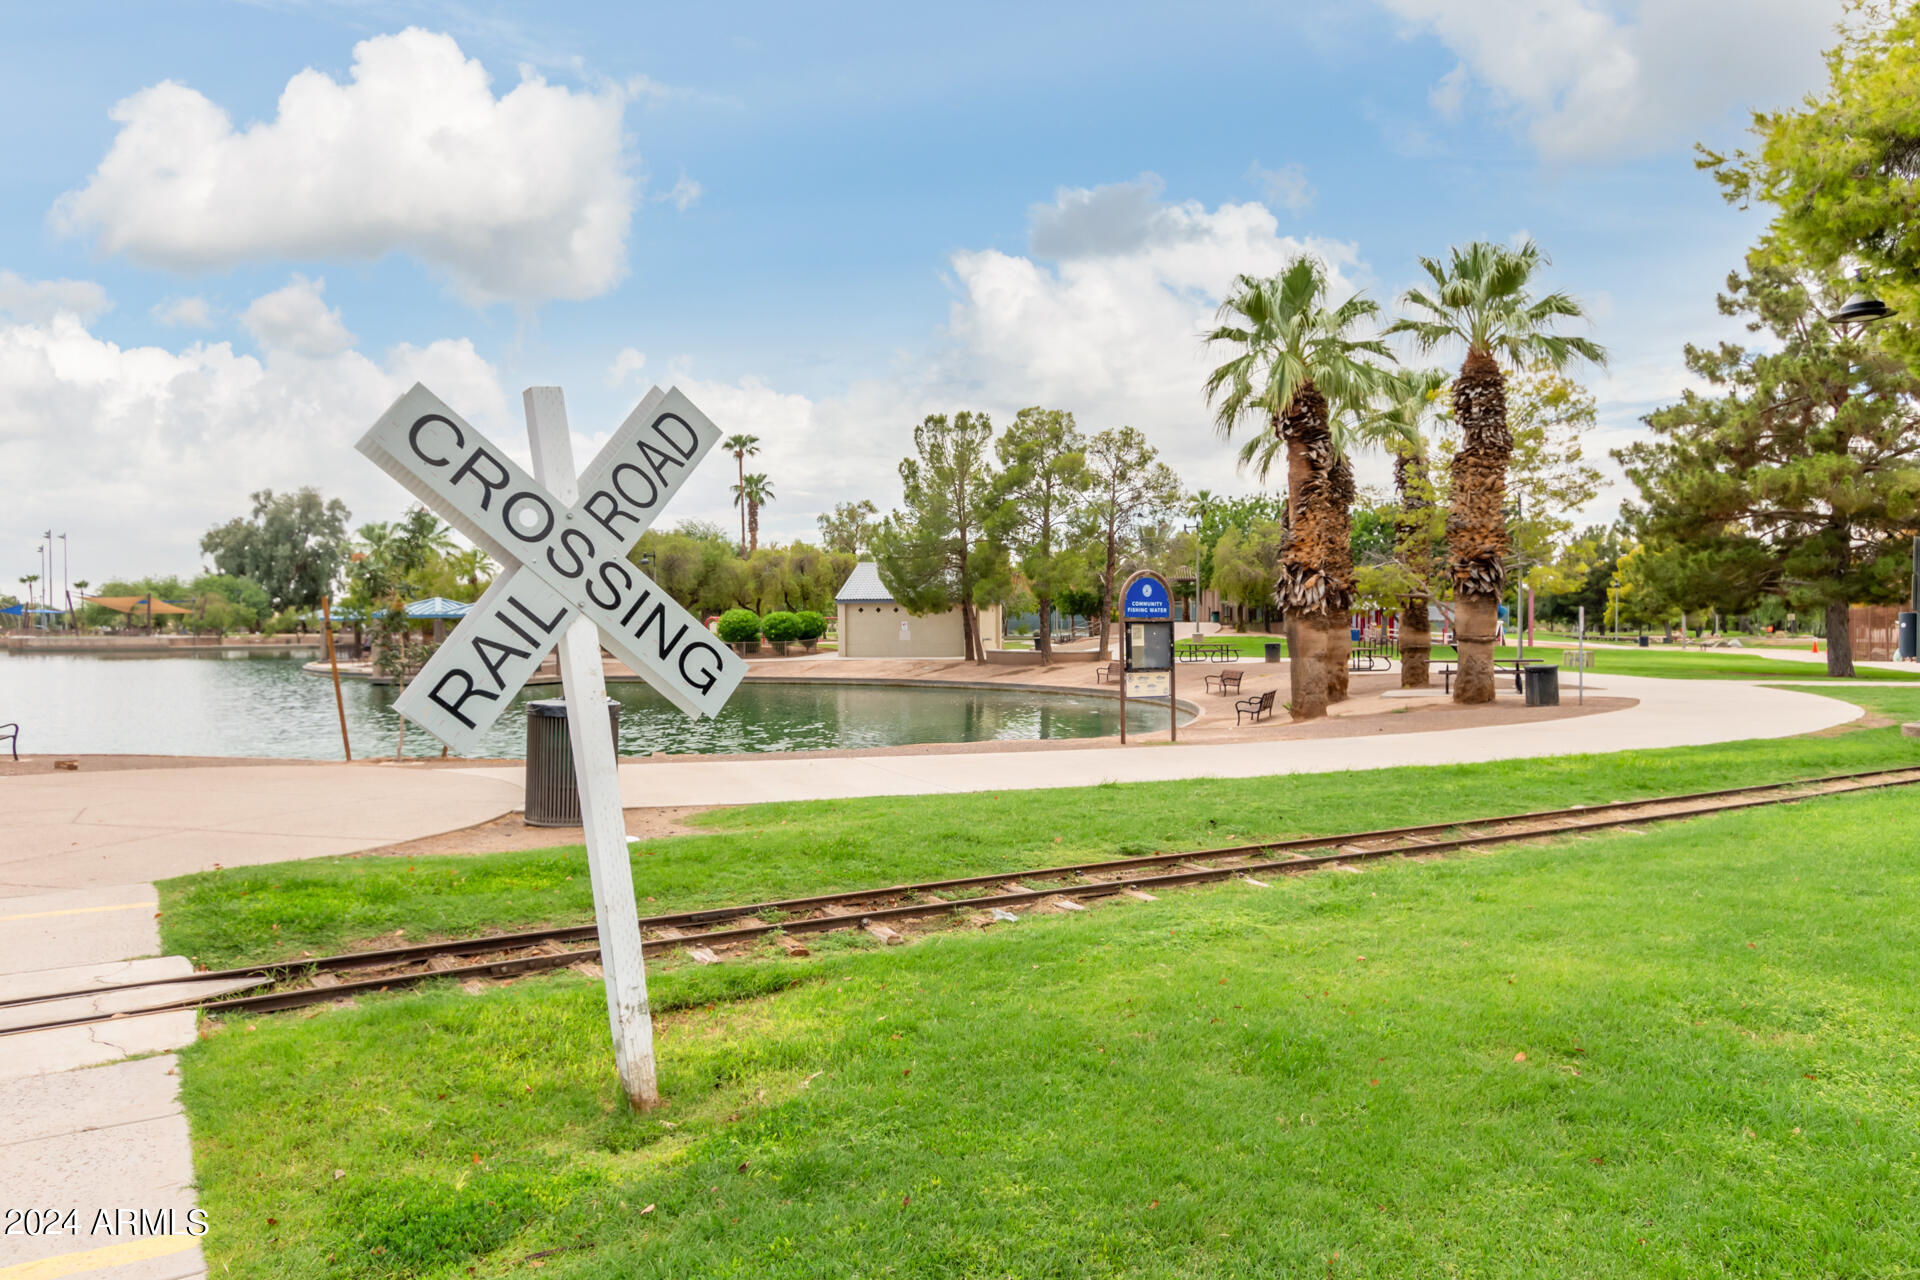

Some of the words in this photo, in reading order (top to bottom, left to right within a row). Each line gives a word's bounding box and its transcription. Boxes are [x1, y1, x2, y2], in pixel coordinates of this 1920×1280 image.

[408, 413, 724, 697] CROSSING
[427, 596, 569, 730] RAIL
[583, 412, 699, 542] ROAD
